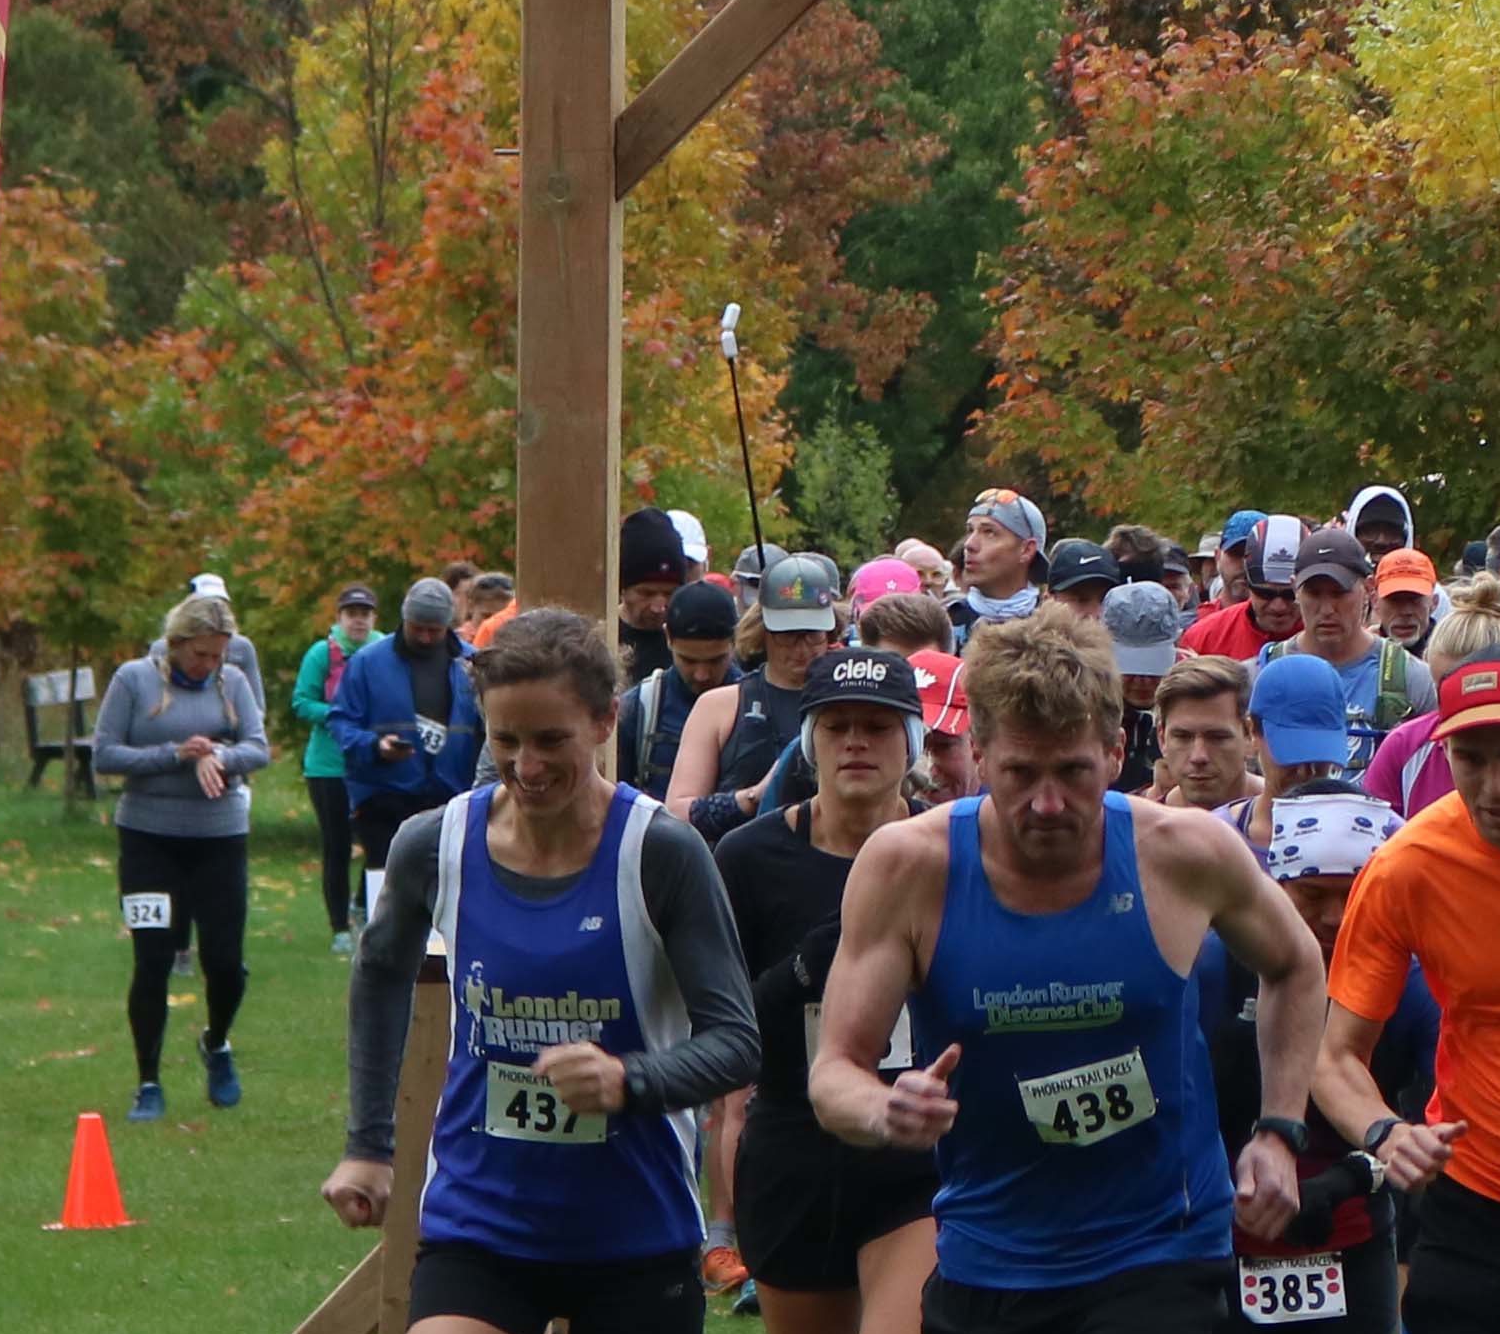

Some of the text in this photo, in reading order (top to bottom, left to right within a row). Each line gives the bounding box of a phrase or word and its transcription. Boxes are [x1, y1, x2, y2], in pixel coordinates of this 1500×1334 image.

[833, 658, 887, 682] ciele
[131, 905, 161, 924] 324
[491, 987, 621, 1020] London
[973, 979, 1125, 1010] London Runner
[987, 995, 1124, 1028] Distance Club
[484, 1017, 604, 1048] Runner
[1032, 1061, 1133, 1099] PHOENIX TRAIL RACES
[1051, 1083, 1135, 1140] 438
[1259, 1273, 1326, 1316] 385
